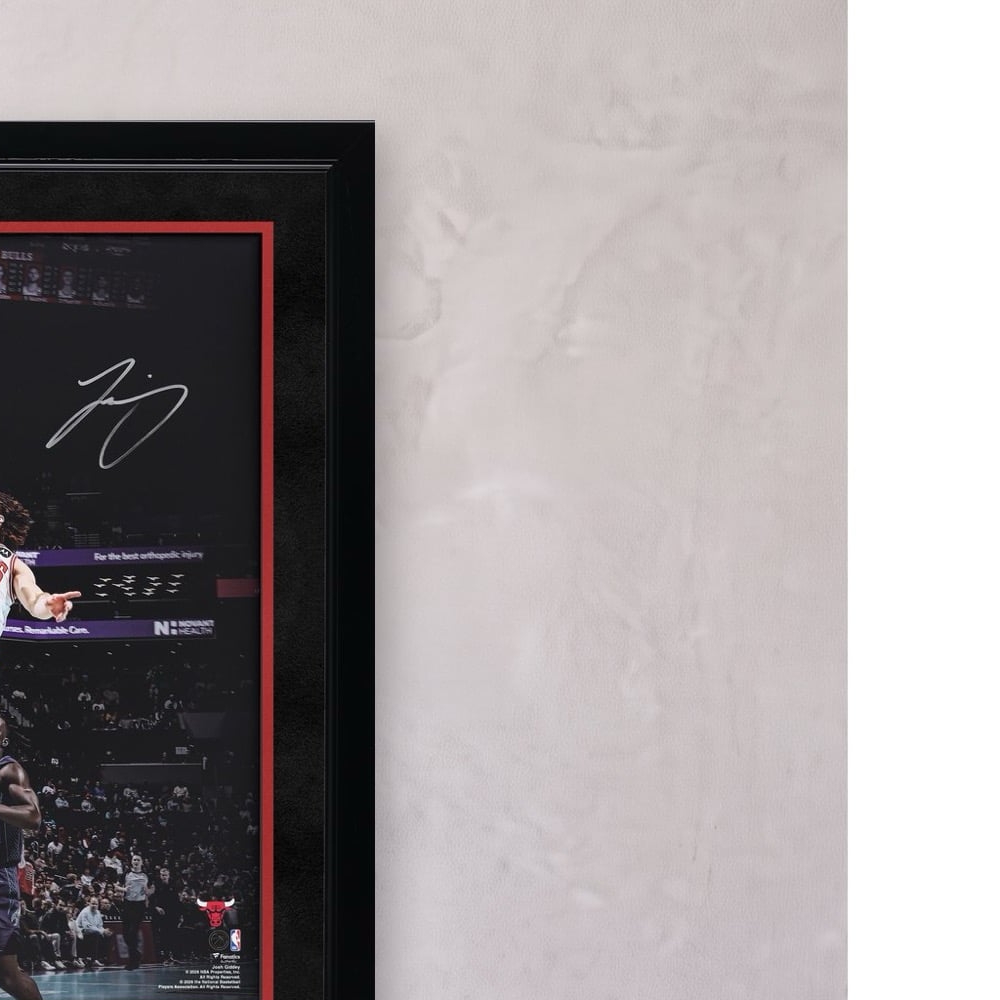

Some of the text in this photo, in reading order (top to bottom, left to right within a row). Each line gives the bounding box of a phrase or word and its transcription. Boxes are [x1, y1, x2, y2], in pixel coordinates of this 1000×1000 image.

[94, 552, 107, 561] For
[108, 552, 121, 560] the
[122, 551, 139, 560] best
